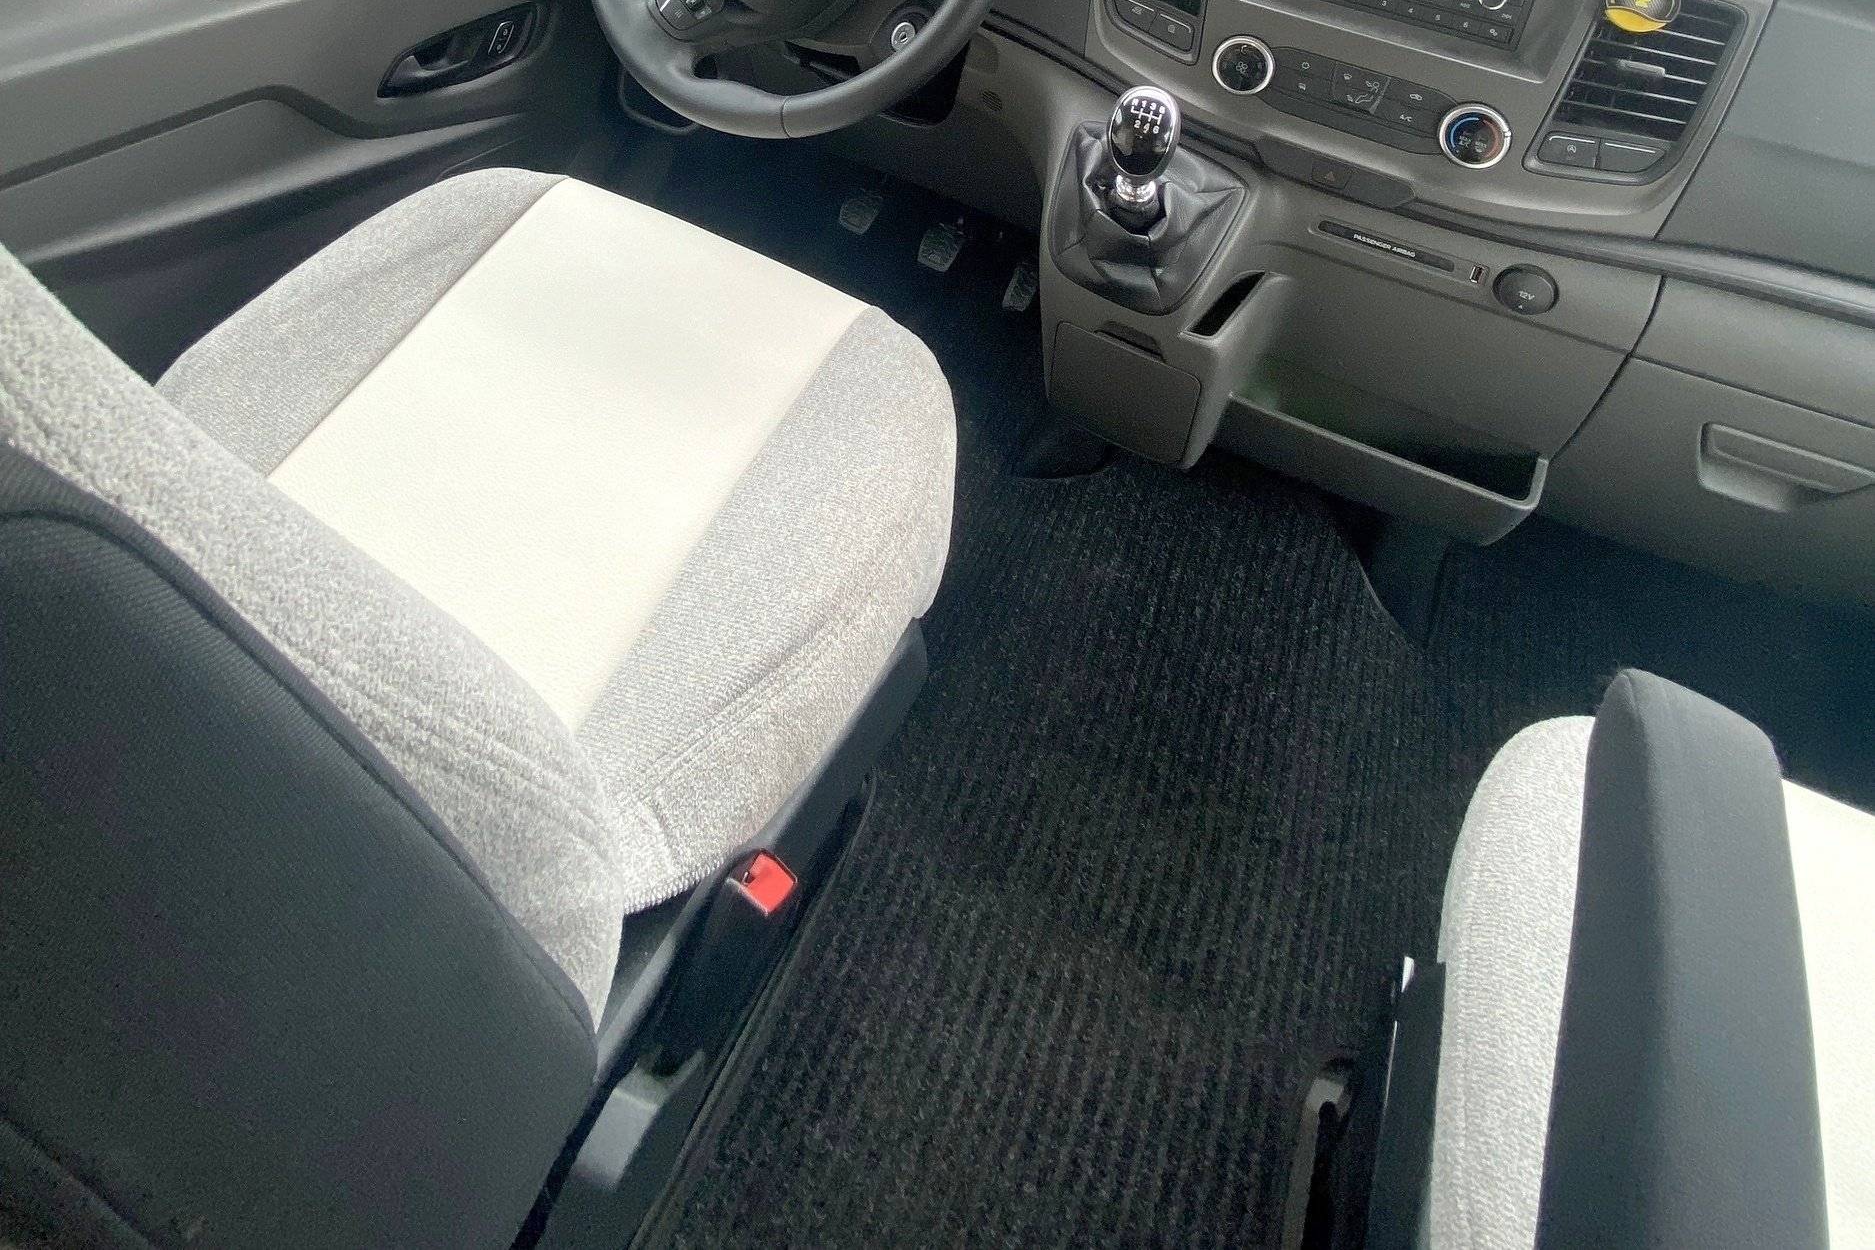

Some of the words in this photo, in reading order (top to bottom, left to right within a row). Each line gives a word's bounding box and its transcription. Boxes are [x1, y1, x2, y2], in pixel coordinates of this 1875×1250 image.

[1150, 102, 1157, 111] 3
[1133, 120, 1141, 129] 2
[1143, 123, 1150, 134] 4
[1152, 125, 1160, 134] 6
[1353, 233, 1392, 250] PASSENGER
[1391, 246, 1416, 258] AIRBAG
[1519, 290, 1535, 301] 12V
